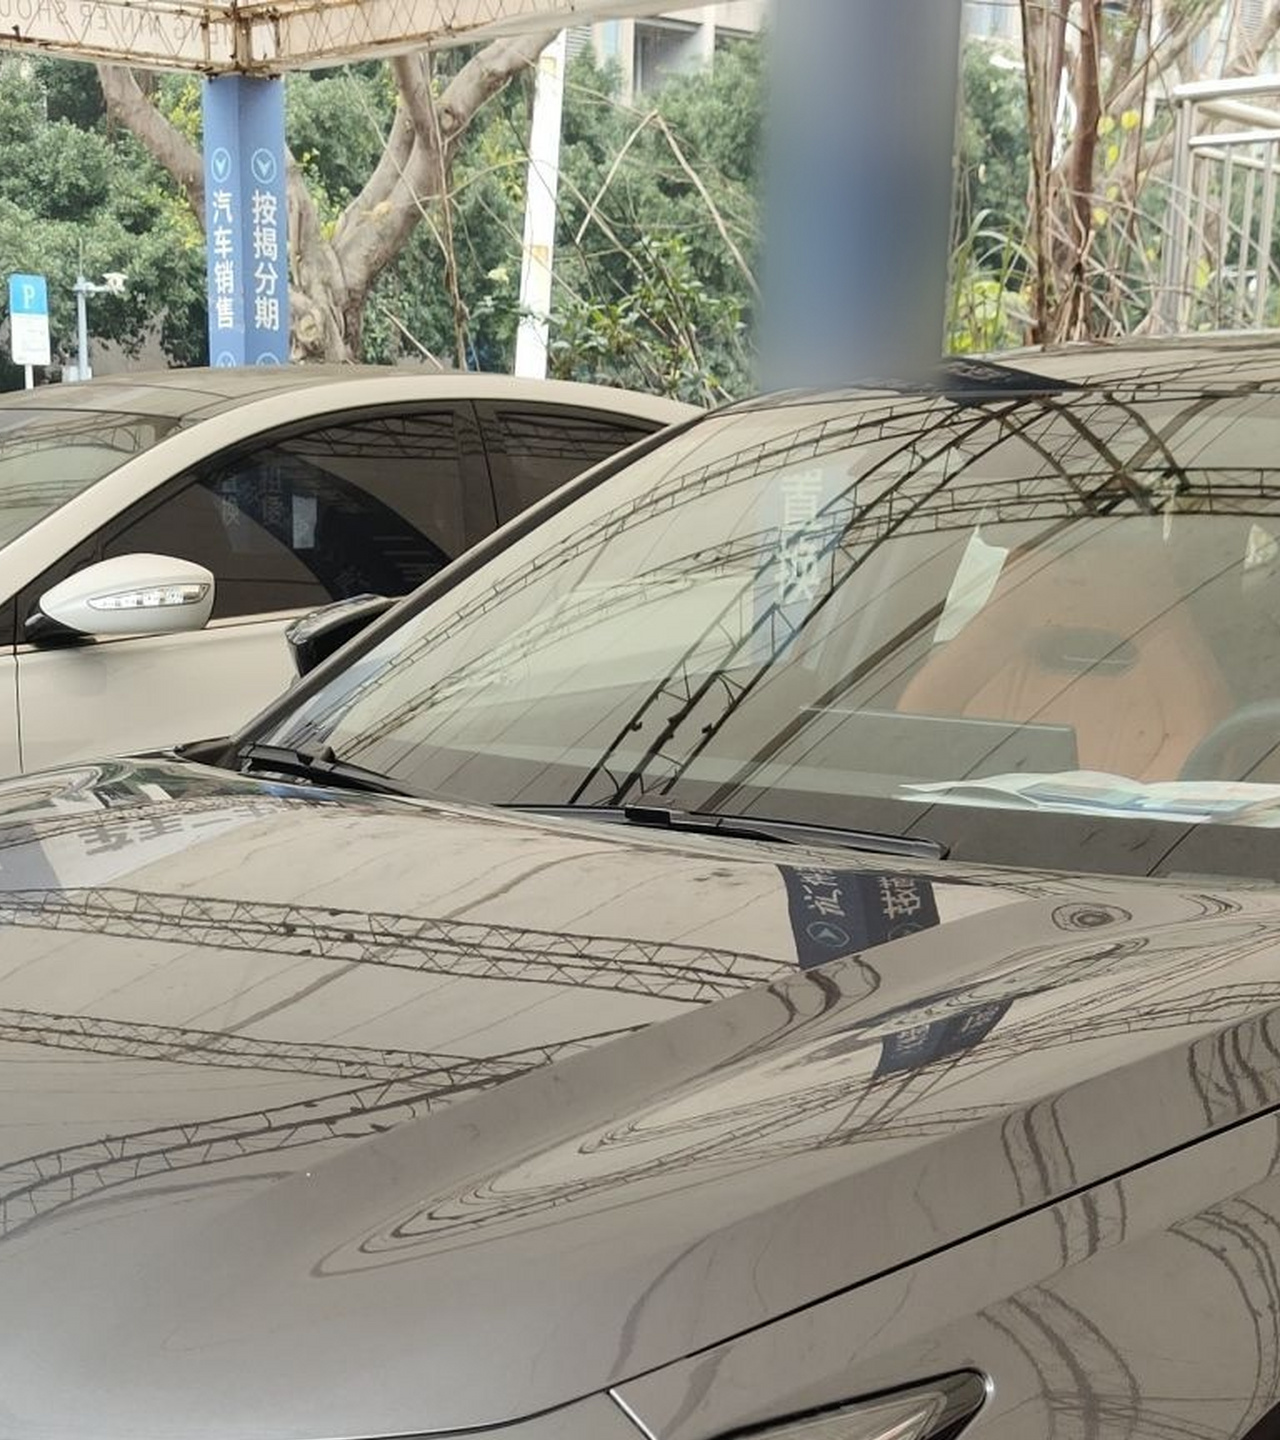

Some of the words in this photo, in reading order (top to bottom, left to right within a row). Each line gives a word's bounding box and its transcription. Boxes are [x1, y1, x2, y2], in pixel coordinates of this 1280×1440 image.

[22, 284, 36, 309] P
[212, 189, 235, 329] 汽车销售
[251, 190, 280, 331] 按揭分期
